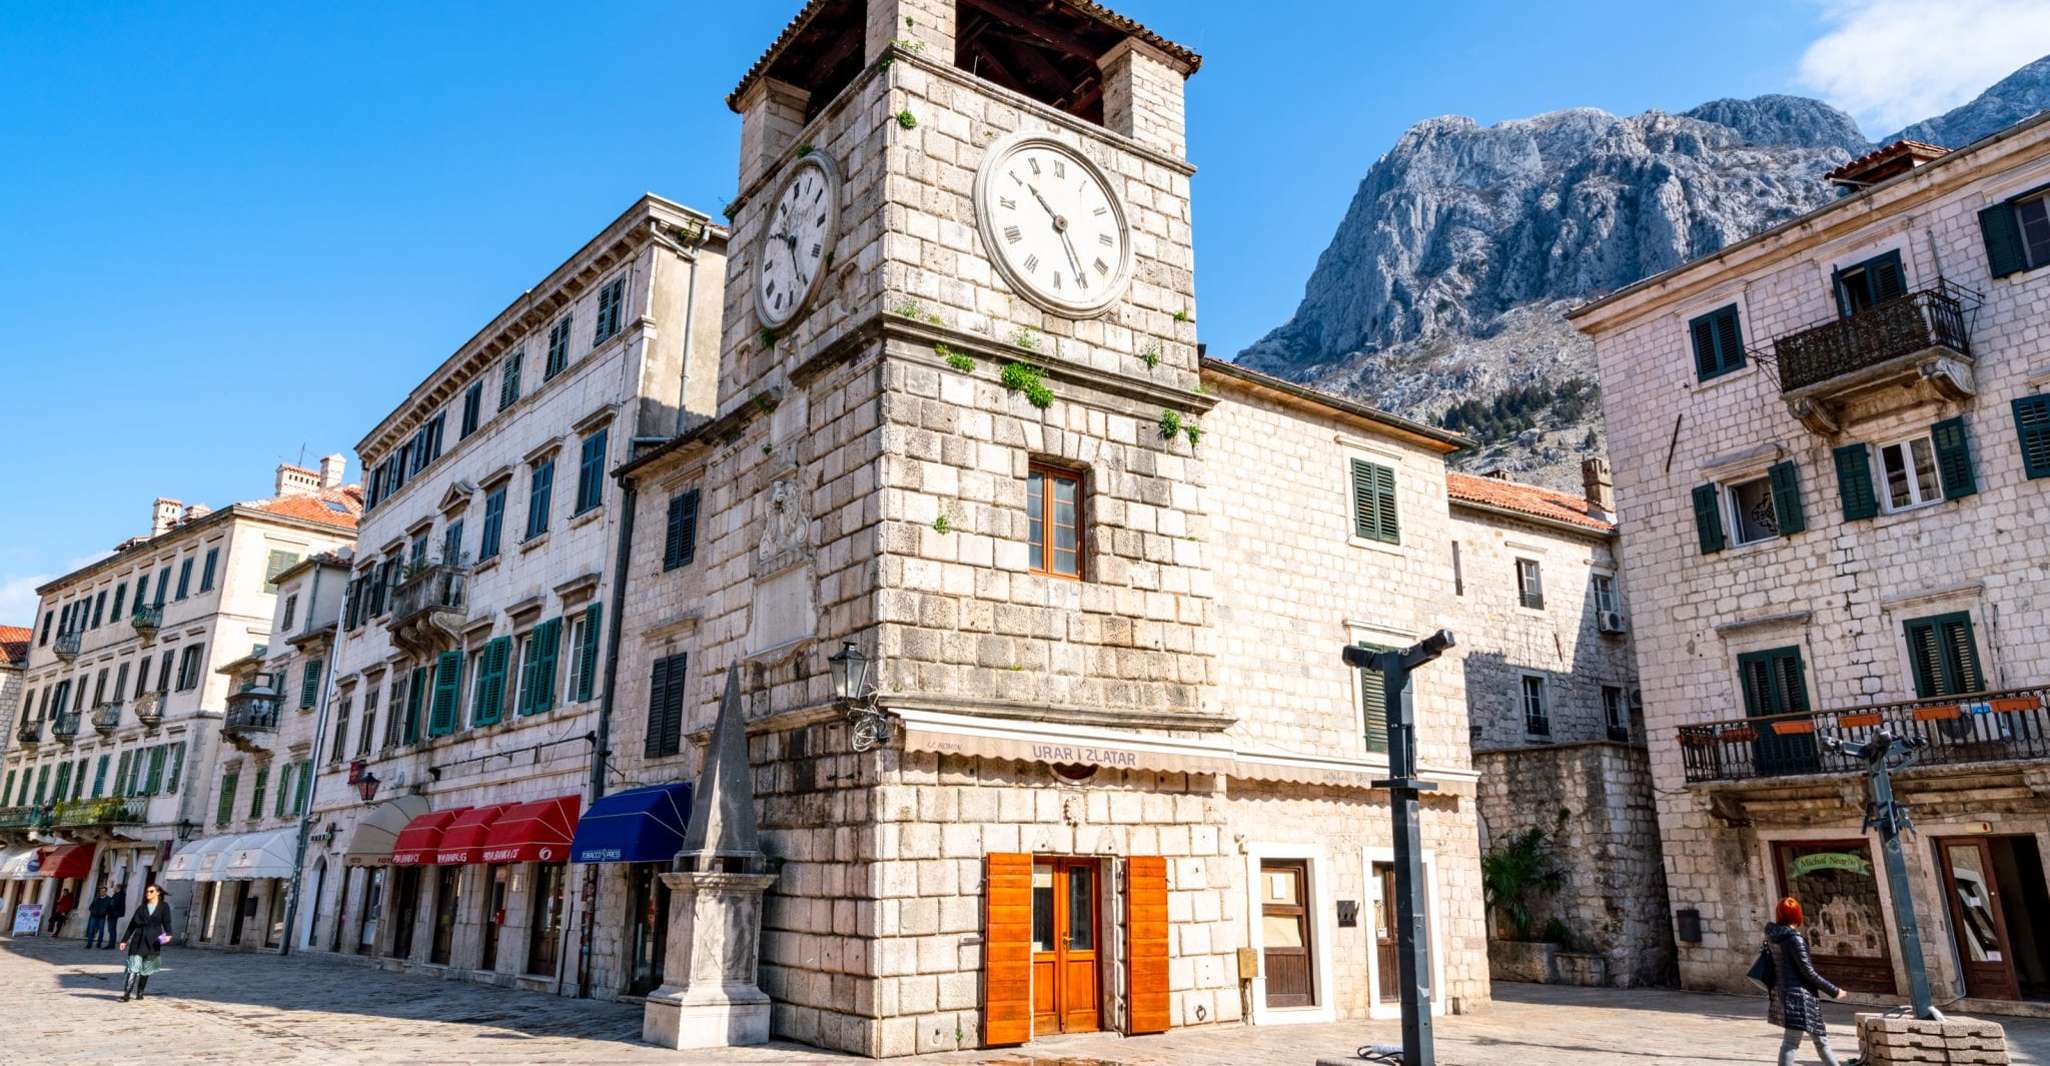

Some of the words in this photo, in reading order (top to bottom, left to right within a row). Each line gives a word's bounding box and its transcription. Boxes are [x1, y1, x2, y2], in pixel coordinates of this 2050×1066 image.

[1032, 744, 1074, 761] URAR
[1077, 746, 1082, 761] I
[1085, 748, 1137, 766] ZLATAR
